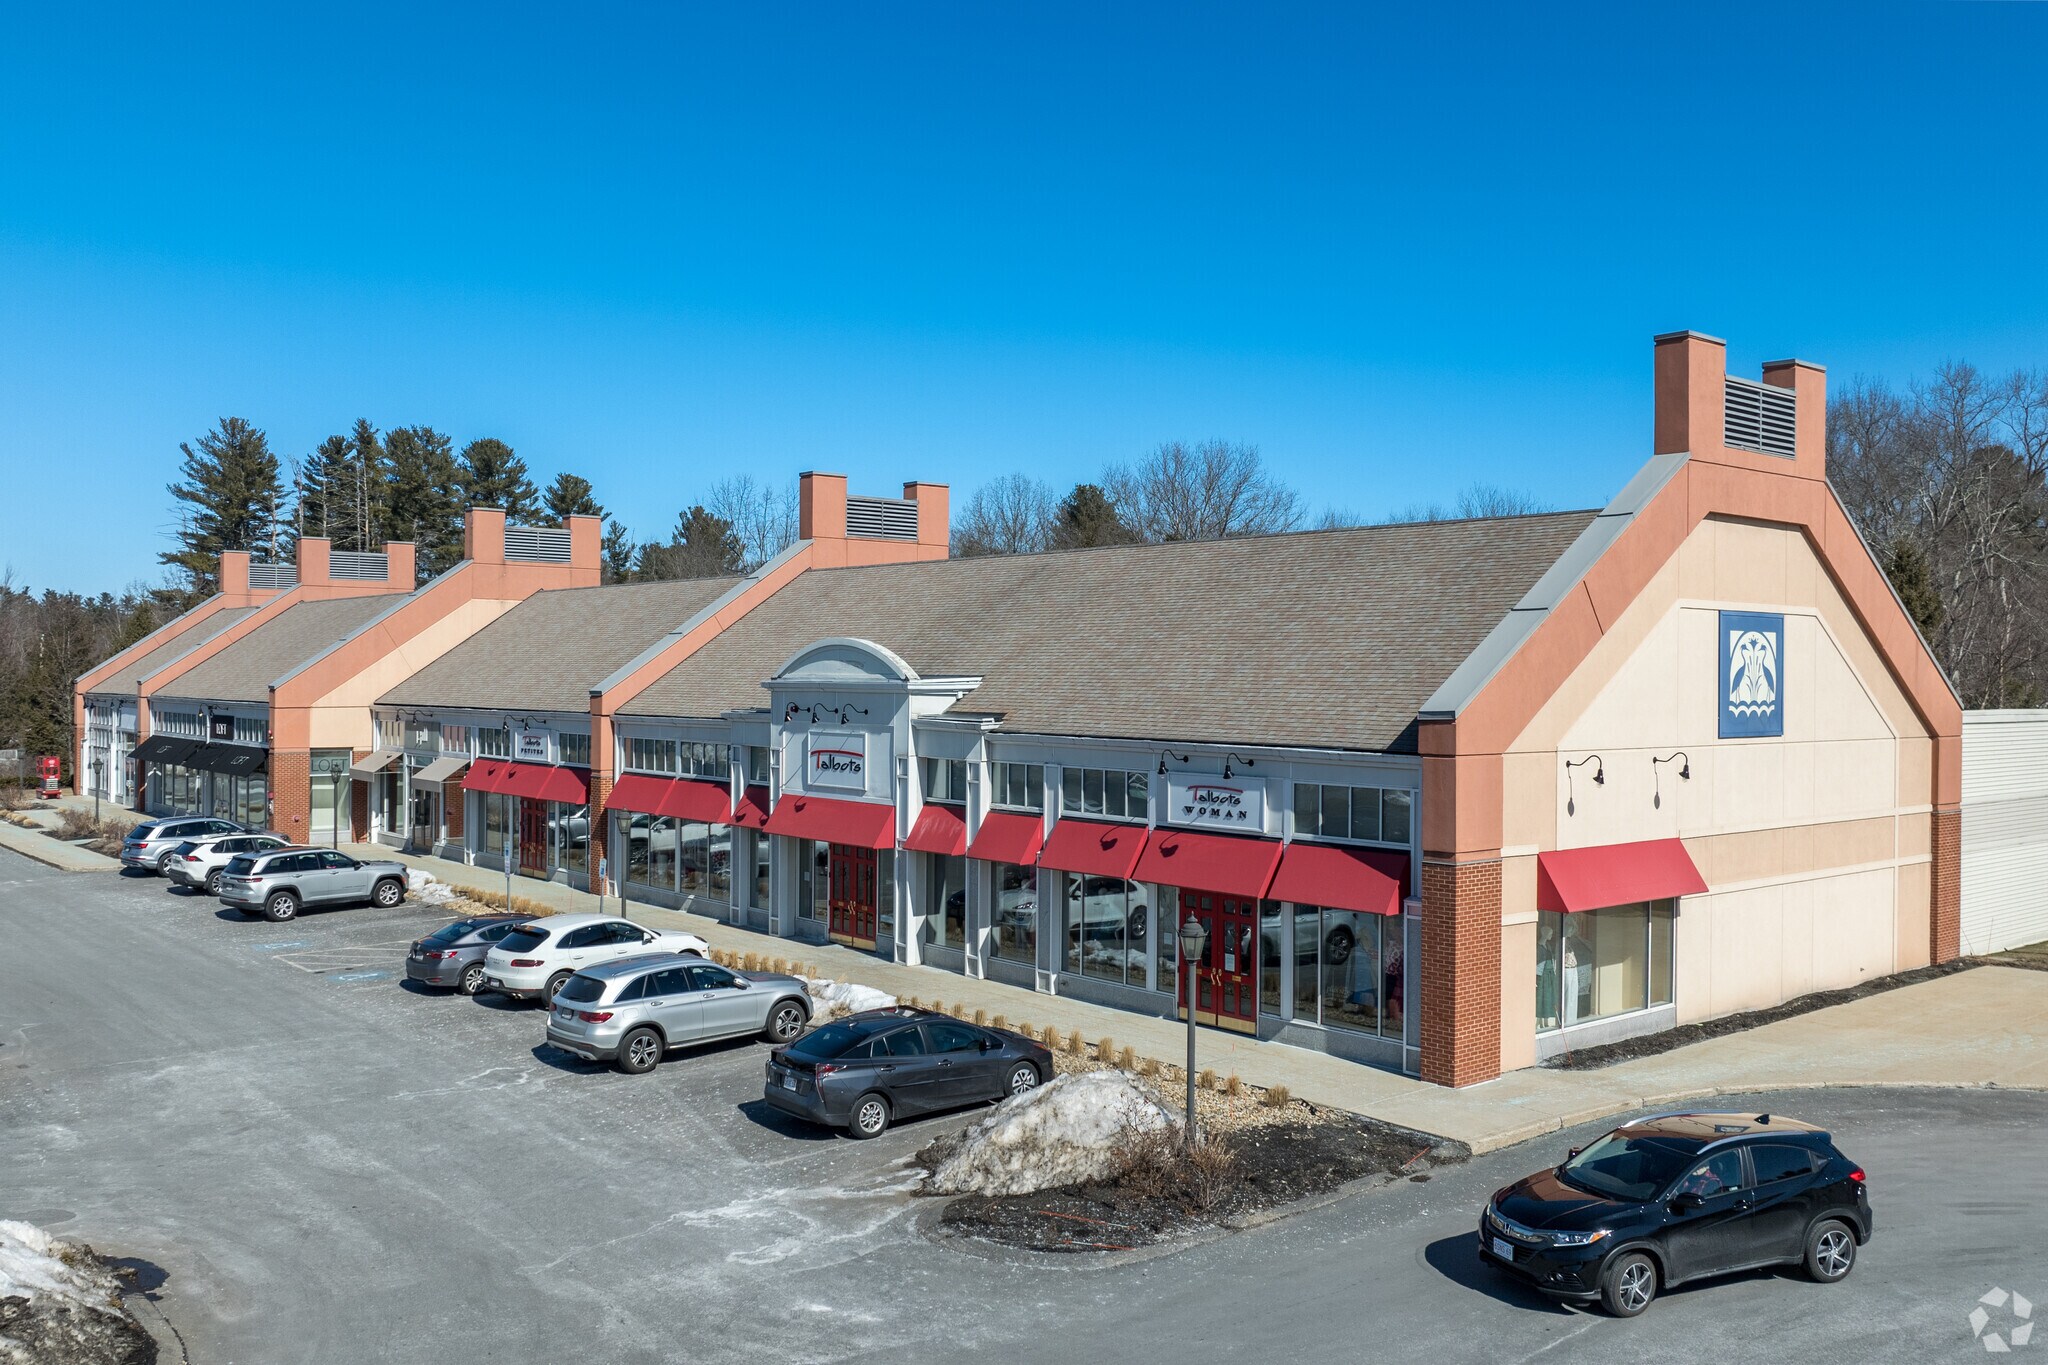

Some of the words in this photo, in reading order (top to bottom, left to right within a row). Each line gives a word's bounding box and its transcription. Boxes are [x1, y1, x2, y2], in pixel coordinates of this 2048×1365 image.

[811, 750, 864, 772] Talbots
[1187, 785, 1244, 805] Talbots
[1184, 806, 1247, 819] WOMAN
